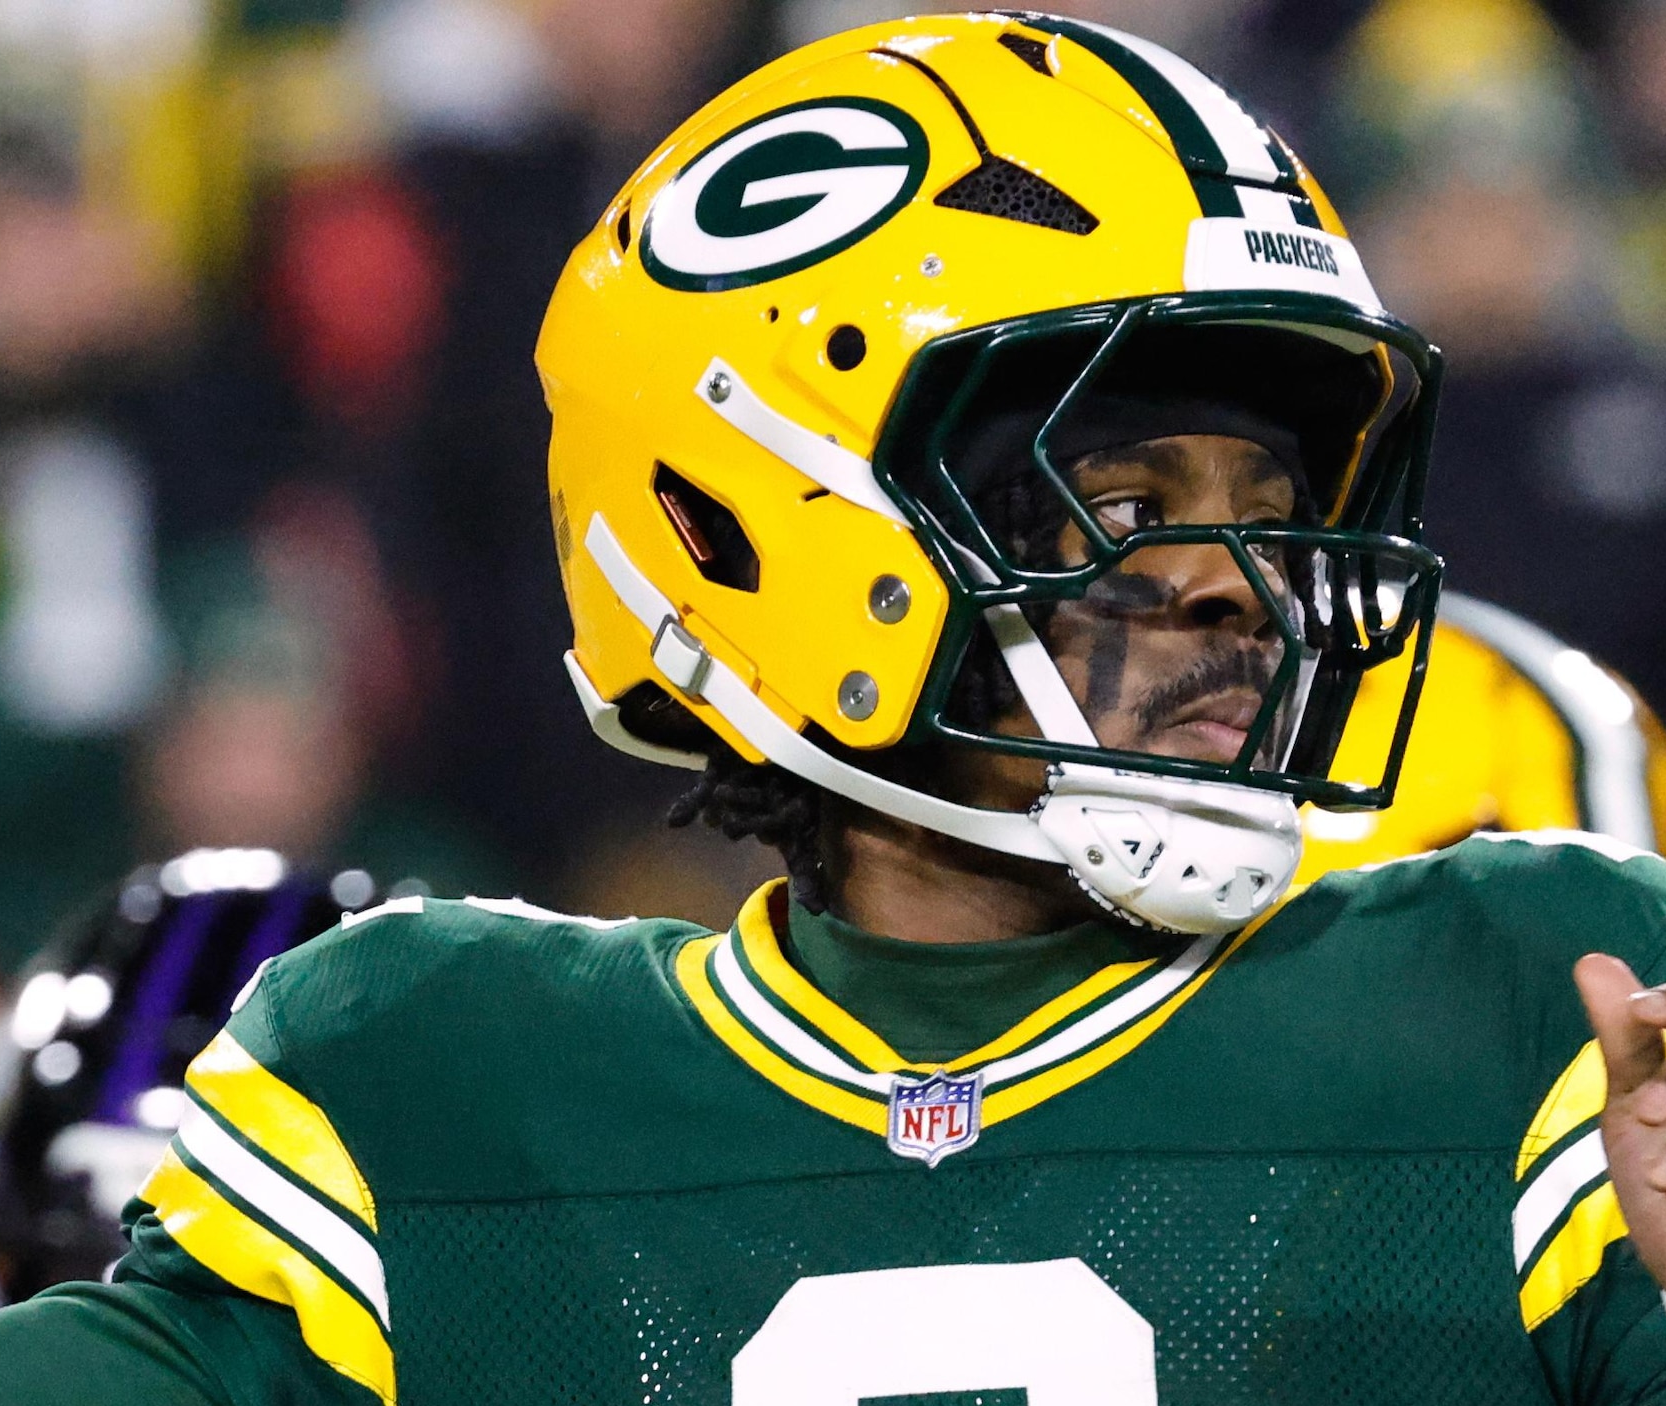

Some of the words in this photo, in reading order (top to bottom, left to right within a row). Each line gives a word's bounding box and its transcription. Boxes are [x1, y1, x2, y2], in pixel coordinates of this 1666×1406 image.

[641, 106, 913, 276] G
[1244, 229, 1339, 276] PACKERS
[901, 1104, 964, 1144] NFL
